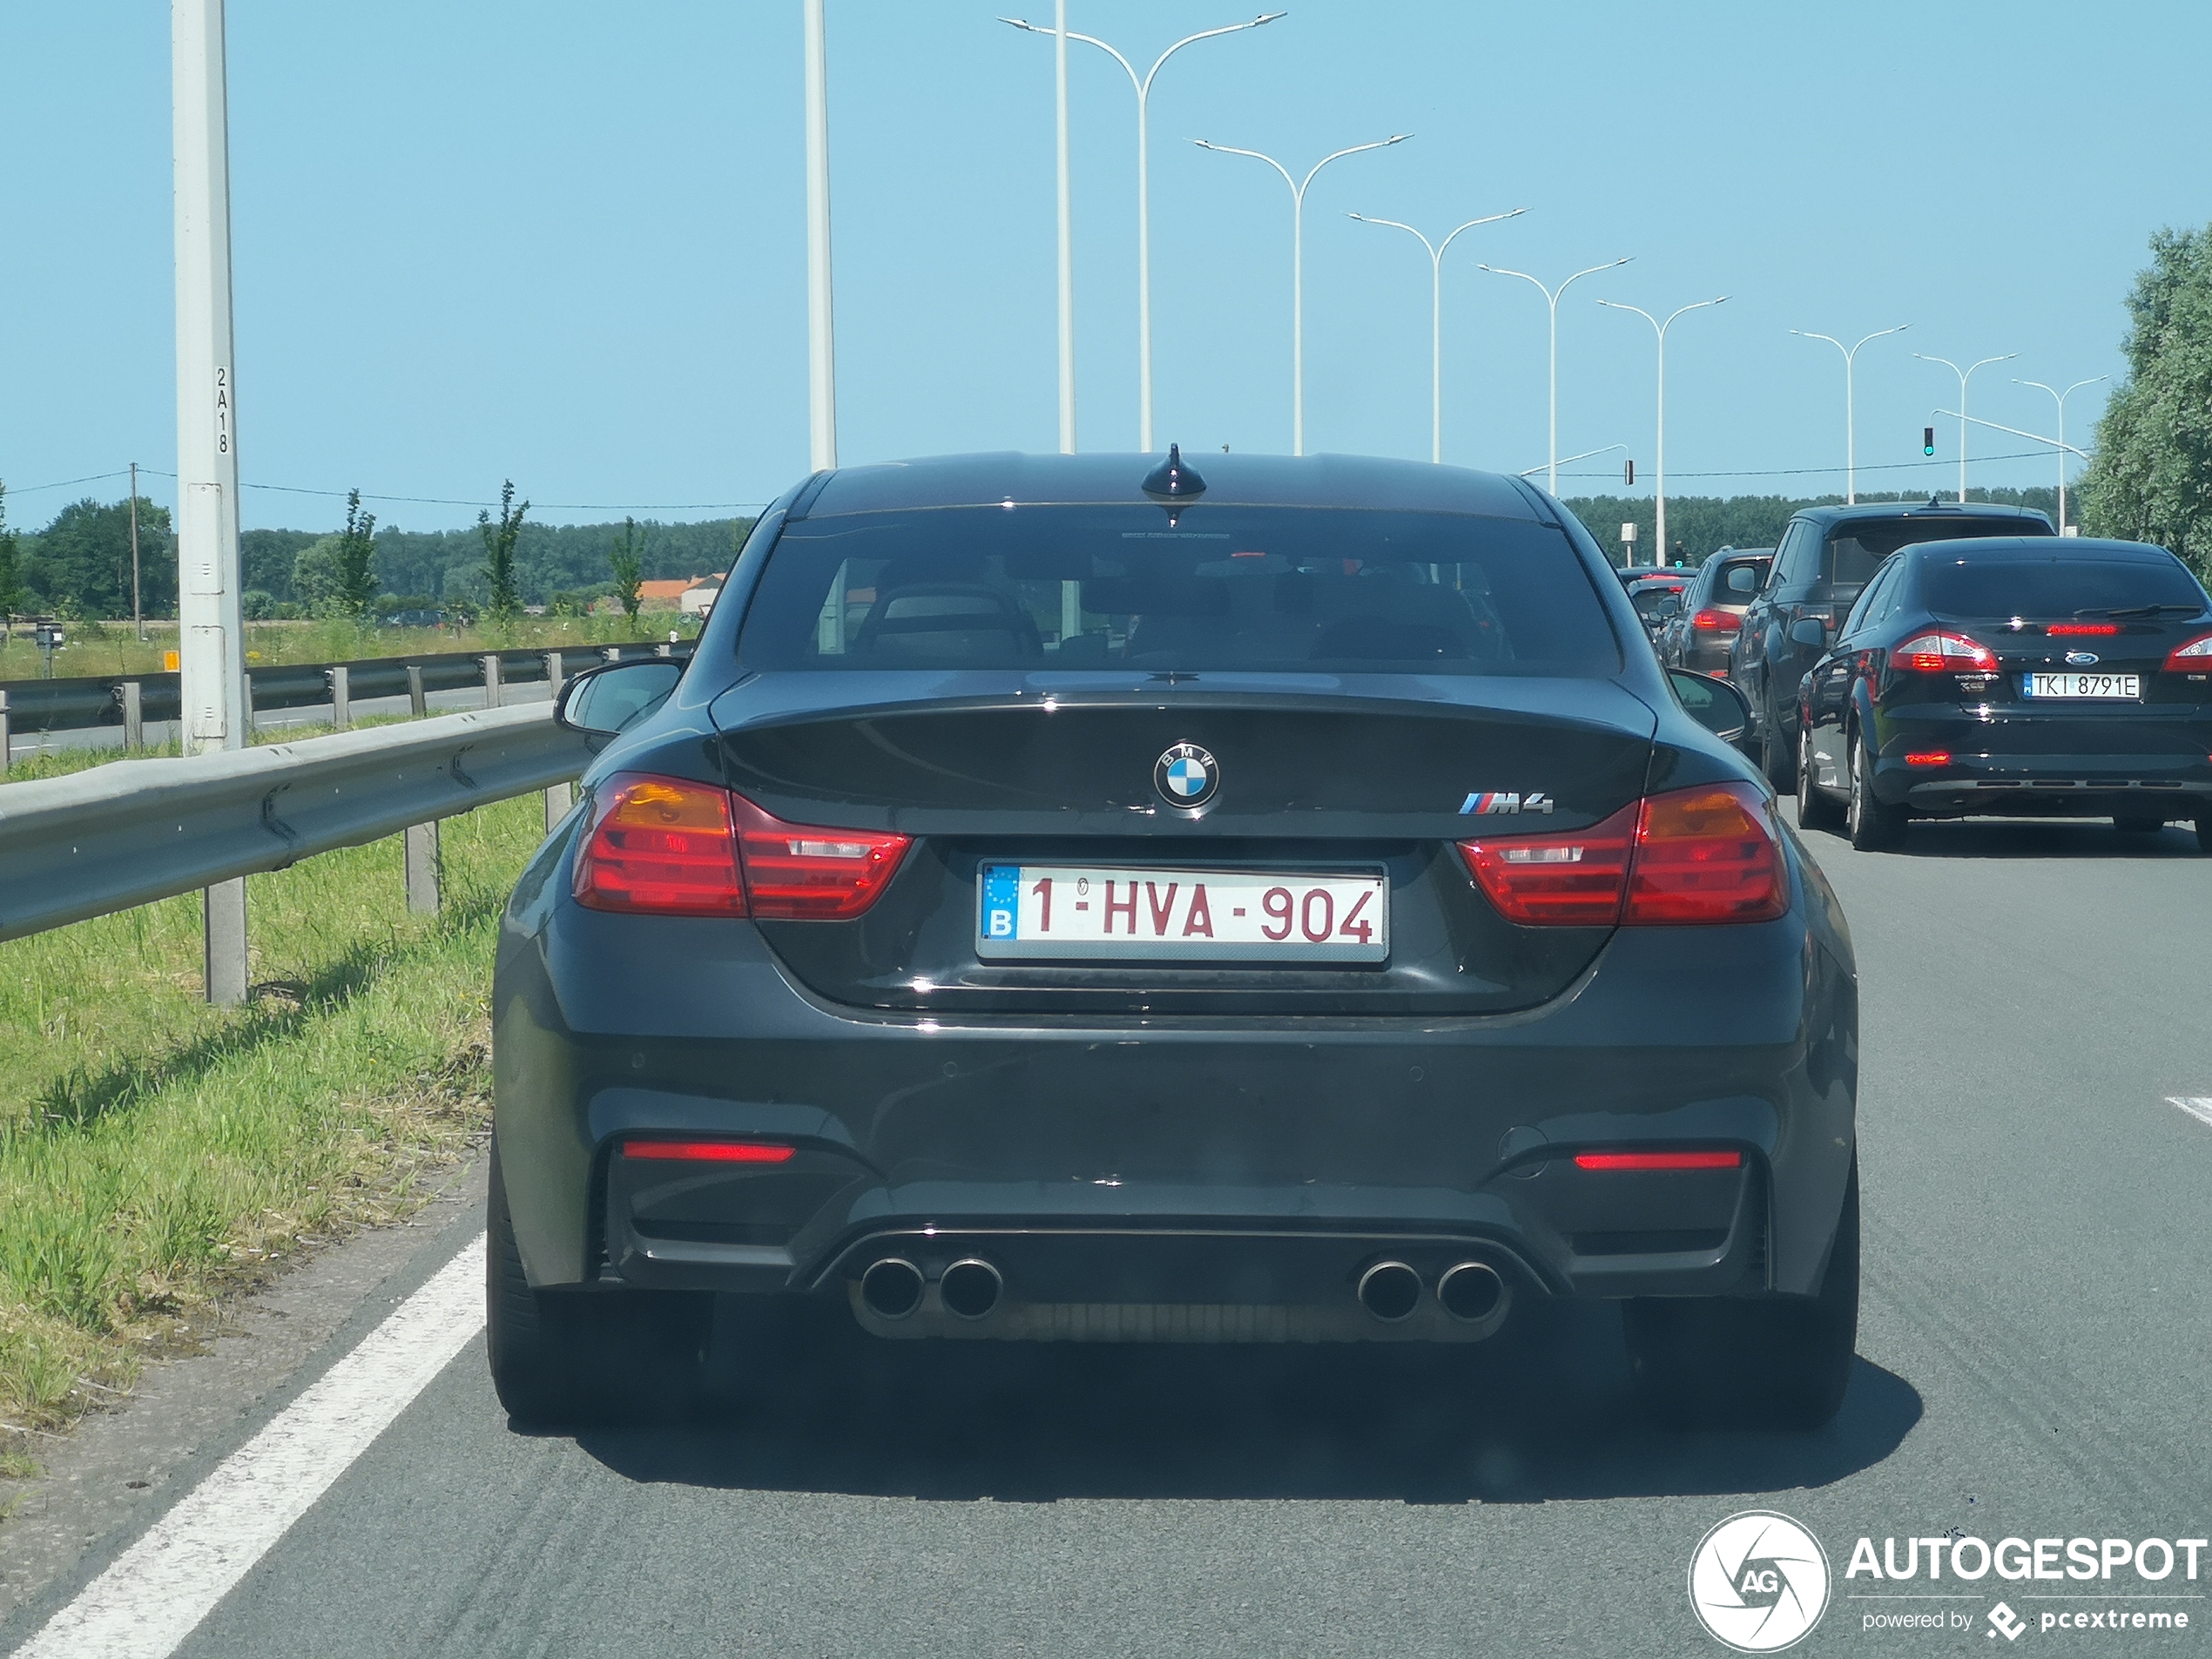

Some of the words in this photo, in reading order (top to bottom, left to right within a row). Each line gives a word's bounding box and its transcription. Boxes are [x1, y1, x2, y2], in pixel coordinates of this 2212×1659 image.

[217, 368, 227, 453] 2A18
[2034, 675, 2067, 695] TKI
[2078, 676, 2136, 696] 8791E
[1161, 746, 1213, 767] BMW
[1483, 792, 1554, 814] M4
[989, 909, 1012, 936] B
[1032, 878, 1373, 944] 1-HVA-904
